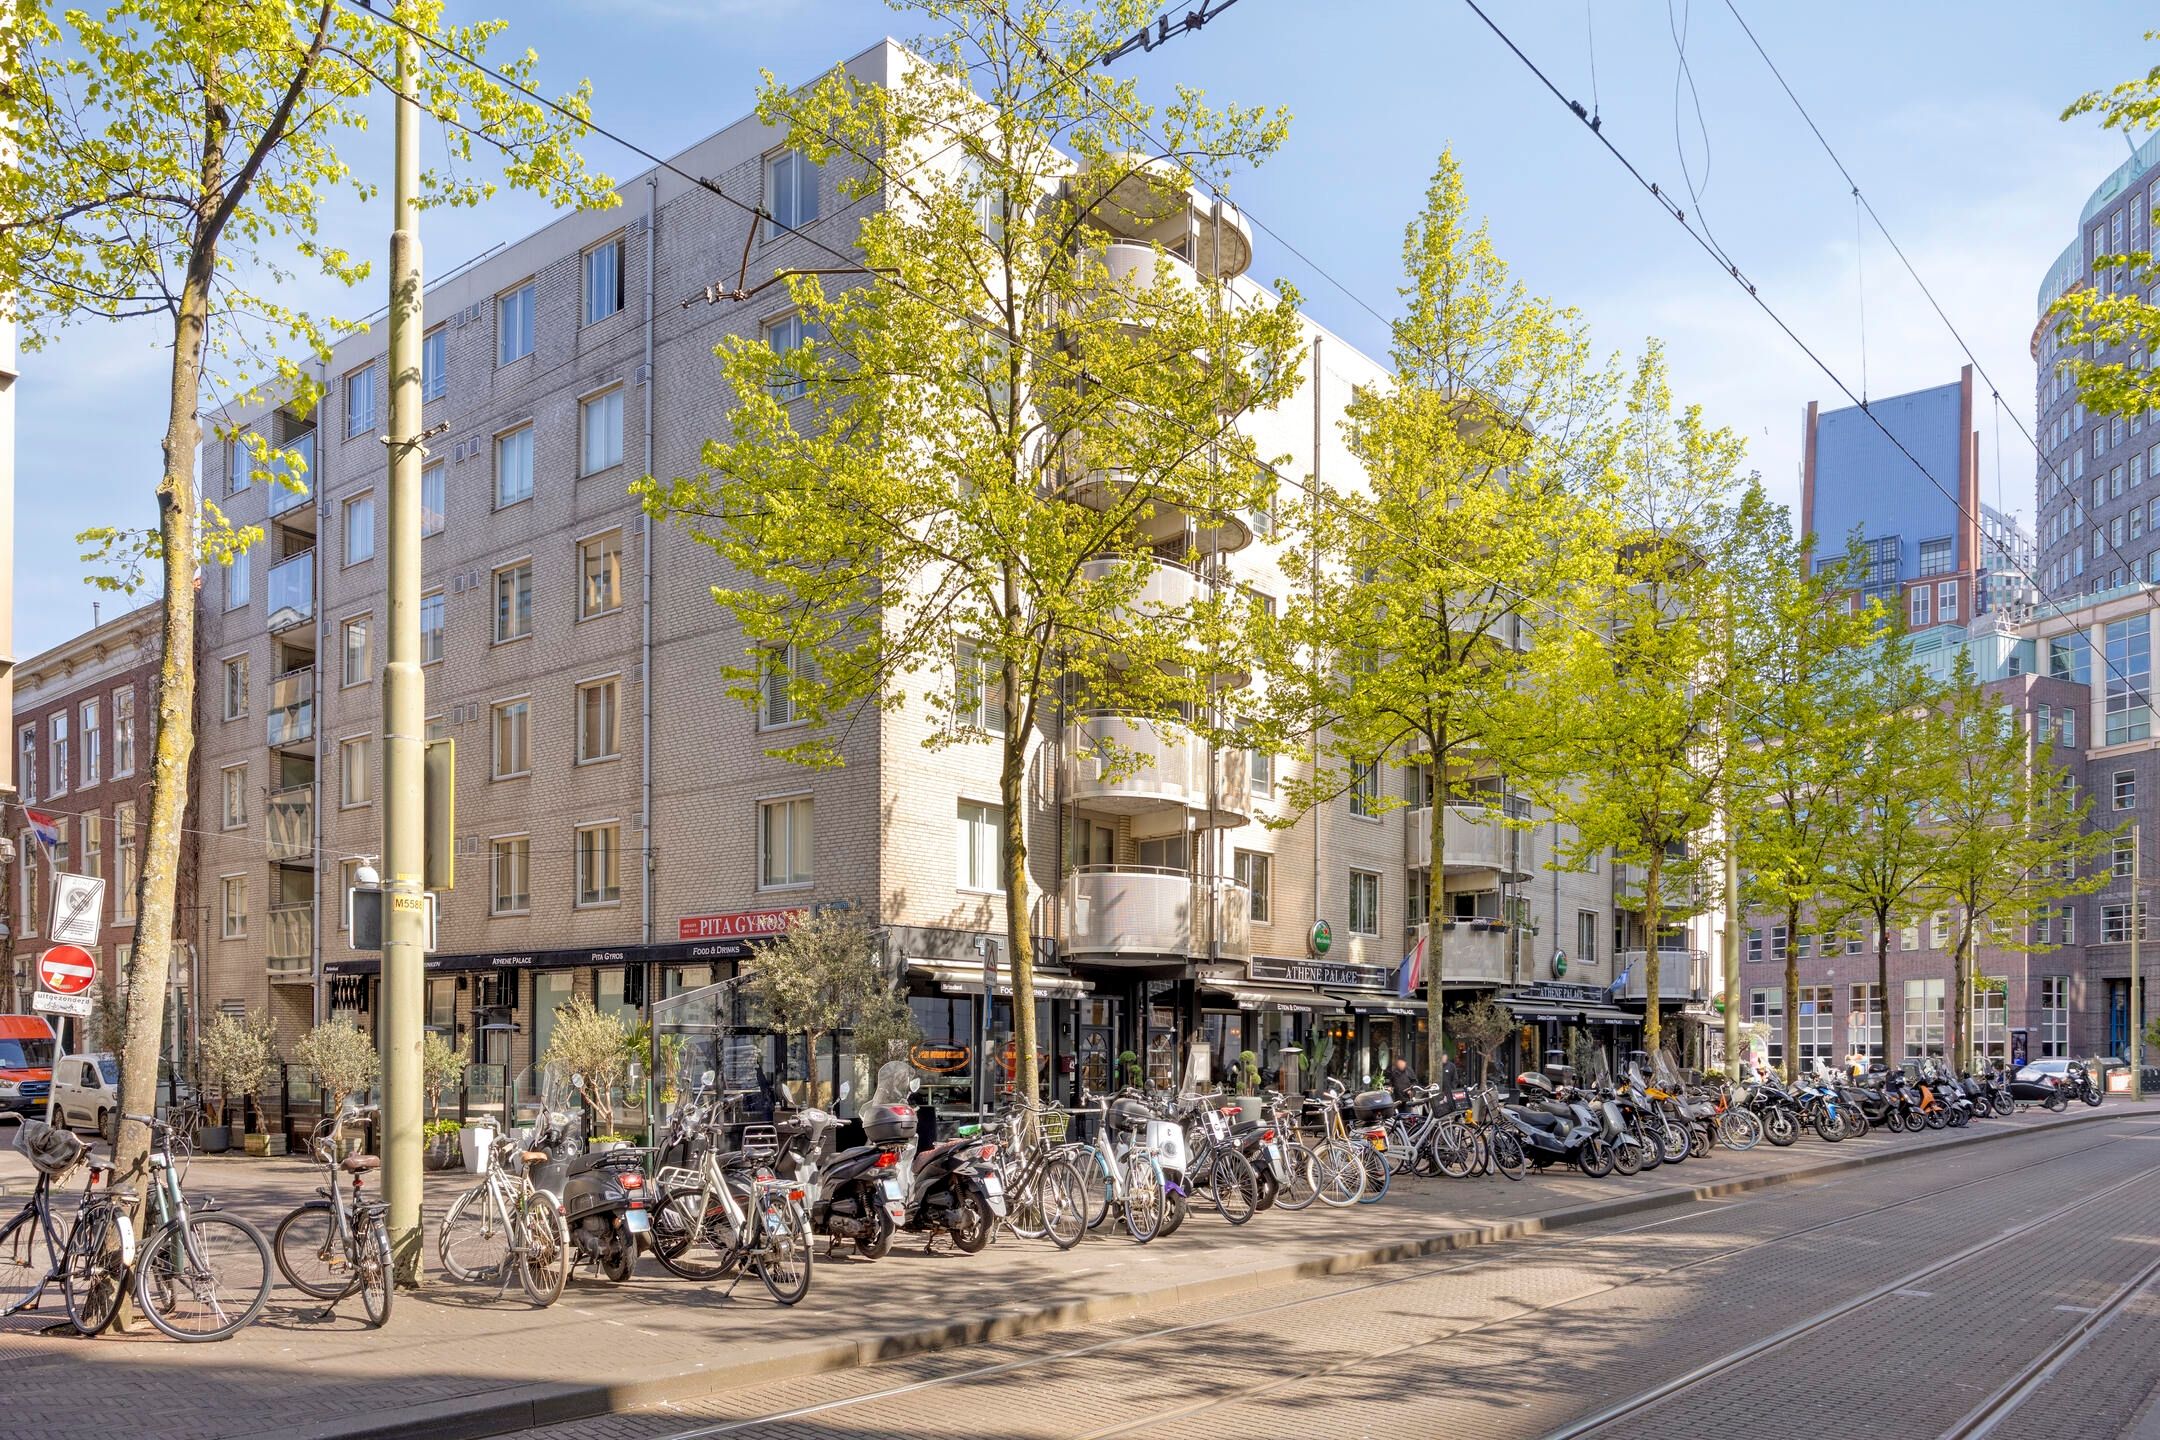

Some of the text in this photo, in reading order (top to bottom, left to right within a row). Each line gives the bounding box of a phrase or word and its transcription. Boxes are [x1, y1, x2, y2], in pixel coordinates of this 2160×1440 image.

[699, 912, 787, 936] PITA GYROS
[591, 952, 624, 961] PITA GYROS
[693, 945, 740, 956] FOOD & DRINKS
[492, 956, 532, 965] ATHENE PALACE
[1285, 966, 1322, 982] ATHENE
[1324, 968, 1358, 985] PALACE
[37, 992, 90, 1005] uitgezonderd
[1540, 986, 1563, 999] ATHENE
[1563, 988, 1585, 1001] PALACE
